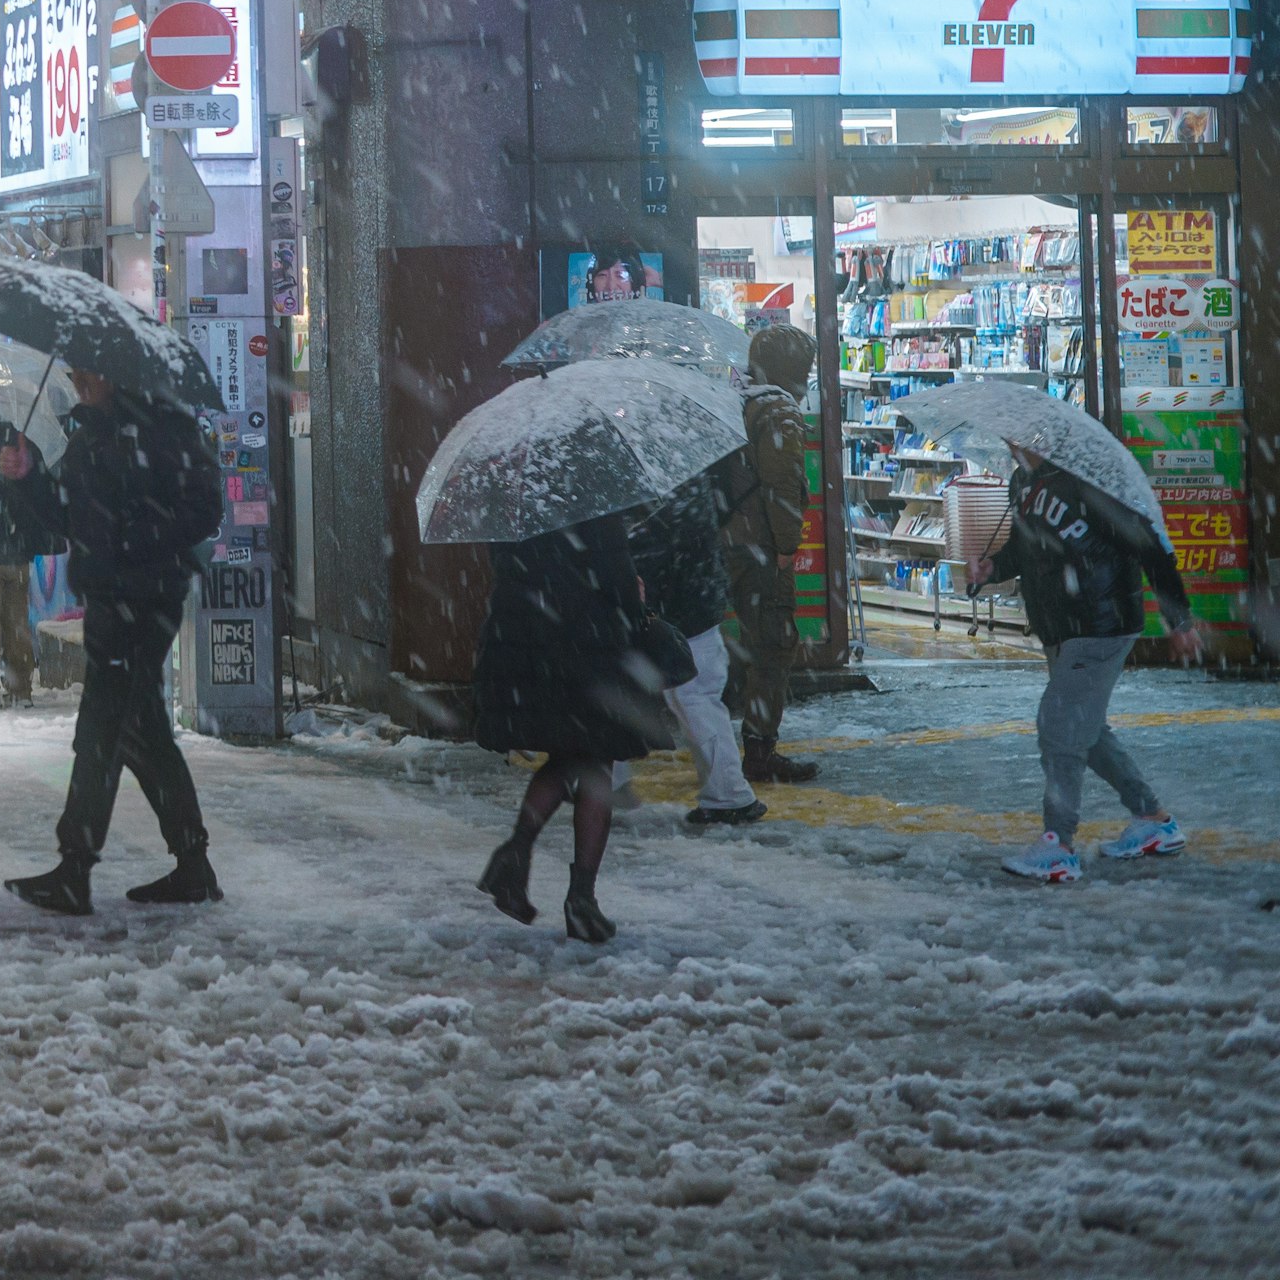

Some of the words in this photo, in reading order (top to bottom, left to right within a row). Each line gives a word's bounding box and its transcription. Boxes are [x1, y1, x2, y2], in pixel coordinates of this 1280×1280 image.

[46, 45, 81, 140] 190
[153, 101, 231, 122] 自転車を除く
[646, 176, 665, 192] 17
[646, 204, 668, 214] 17-2
[1129, 211, 1214, 231] ATM
[1138, 231, 1205, 243] 入り口は
[1120, 287, 1190, 318] たばこ
[1202, 287, 1233, 318] 酒
[1134, 320, 1177, 330] cigarette
[1207, 320, 1234, 330] liquor
[227, 329, 239, 402] 防犯カメラ作動中
[201, 568, 266, 609] NERO
